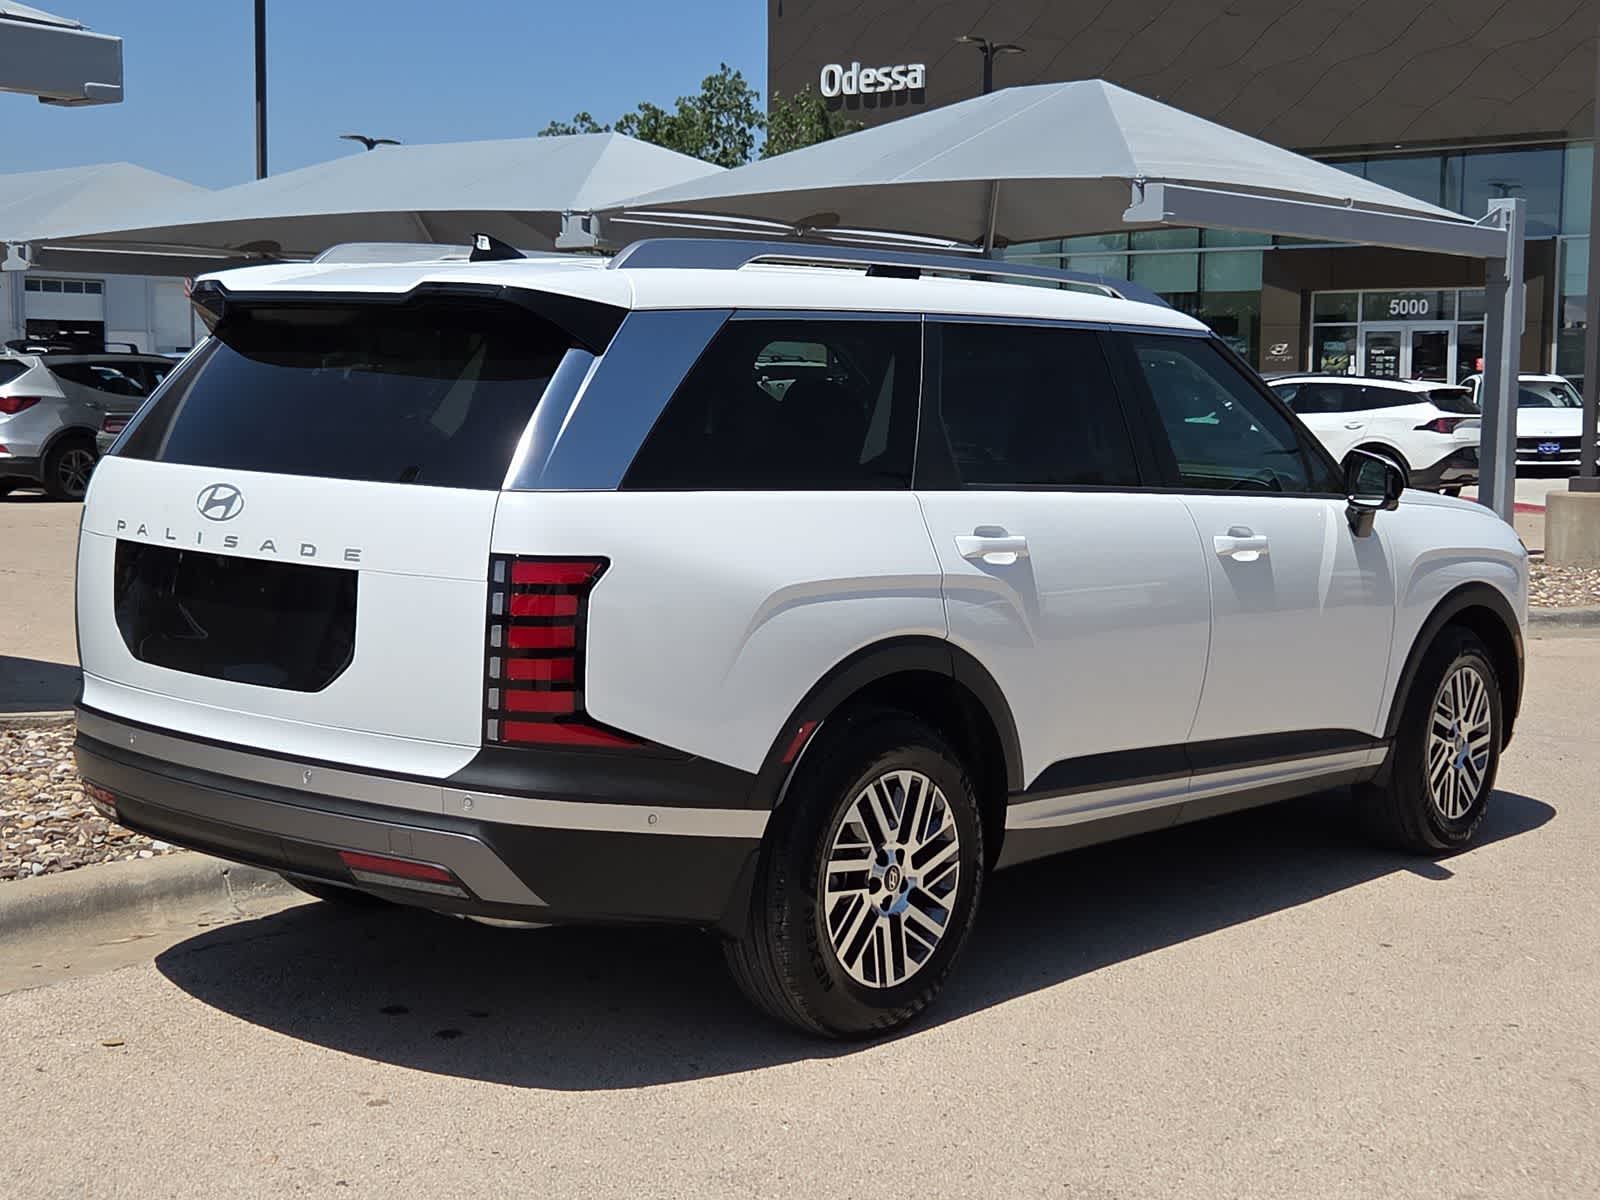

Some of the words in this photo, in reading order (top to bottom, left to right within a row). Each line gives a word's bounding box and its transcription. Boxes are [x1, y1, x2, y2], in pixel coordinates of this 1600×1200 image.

[820, 61, 926, 97] Odessa
[1389, 299, 1429, 315] 5000
[116, 519, 362, 562] PALISADE
